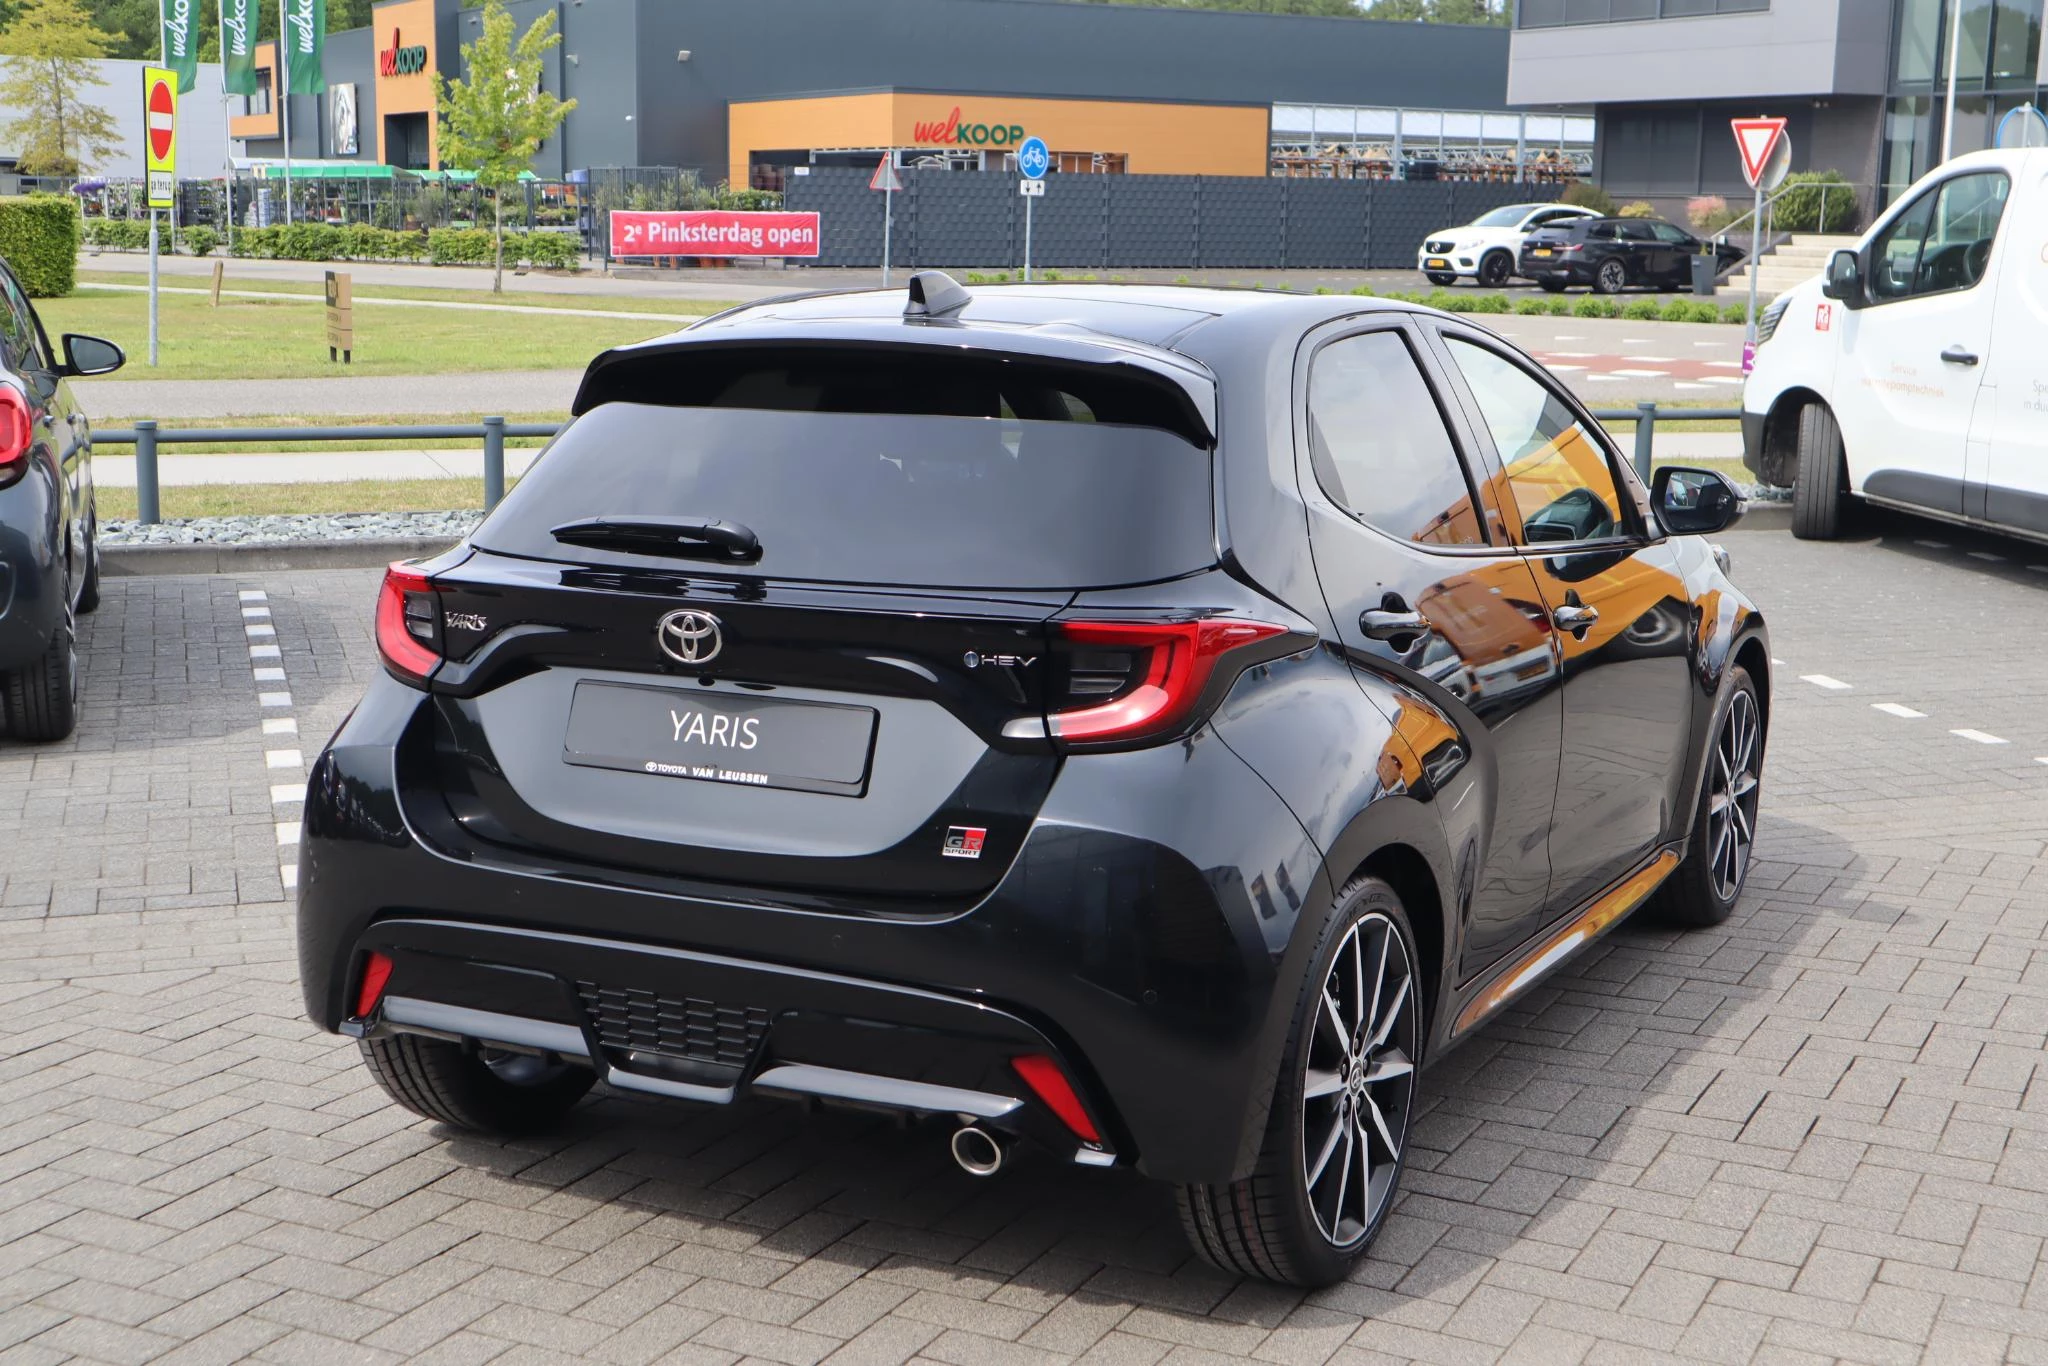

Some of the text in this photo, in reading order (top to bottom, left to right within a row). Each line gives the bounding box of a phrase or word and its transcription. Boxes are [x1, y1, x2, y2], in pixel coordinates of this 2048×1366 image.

[649, 222, 764, 248] Pinksterdag
[768, 227, 813, 248] open
[445, 611, 487, 631] YARIS
[981, 654, 1037, 667] HEV
[670, 709, 760, 750] YARIS
[657, 763, 768, 784] TOYOTA VAN LEUSSEN
[944, 848, 979, 856] SPORT
[946, 836, 982, 850] GR
